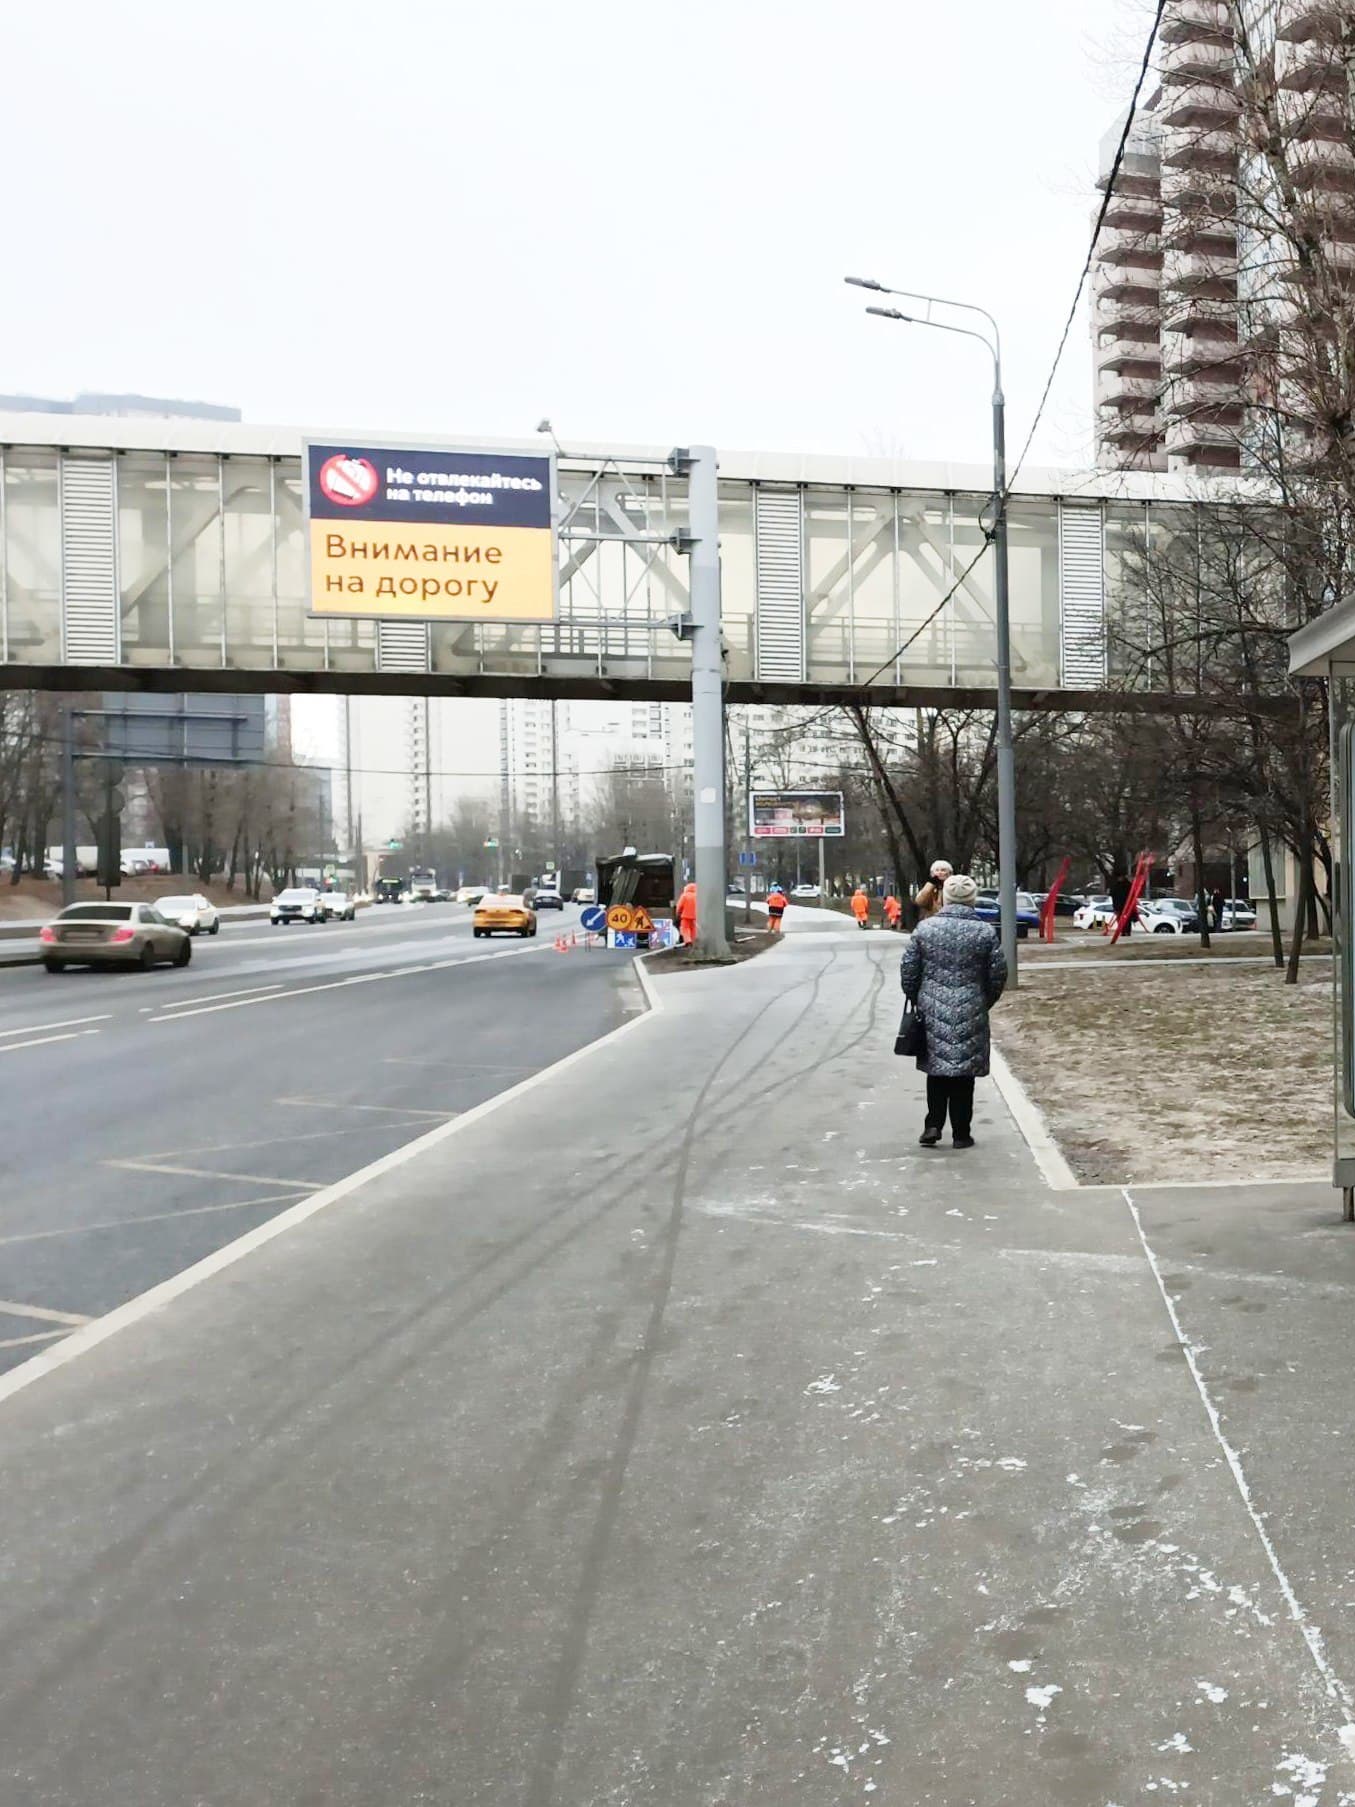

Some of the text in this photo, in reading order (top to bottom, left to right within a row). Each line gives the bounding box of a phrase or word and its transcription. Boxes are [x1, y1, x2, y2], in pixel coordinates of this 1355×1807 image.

[386, 467, 543, 491] Не отвлекайтесь
[386, 487, 494, 507] на телефон
[326, 534, 502, 564] Внимание
[326, 575, 499, 603] на дорогу
[612, 914, 628, 923] 40
